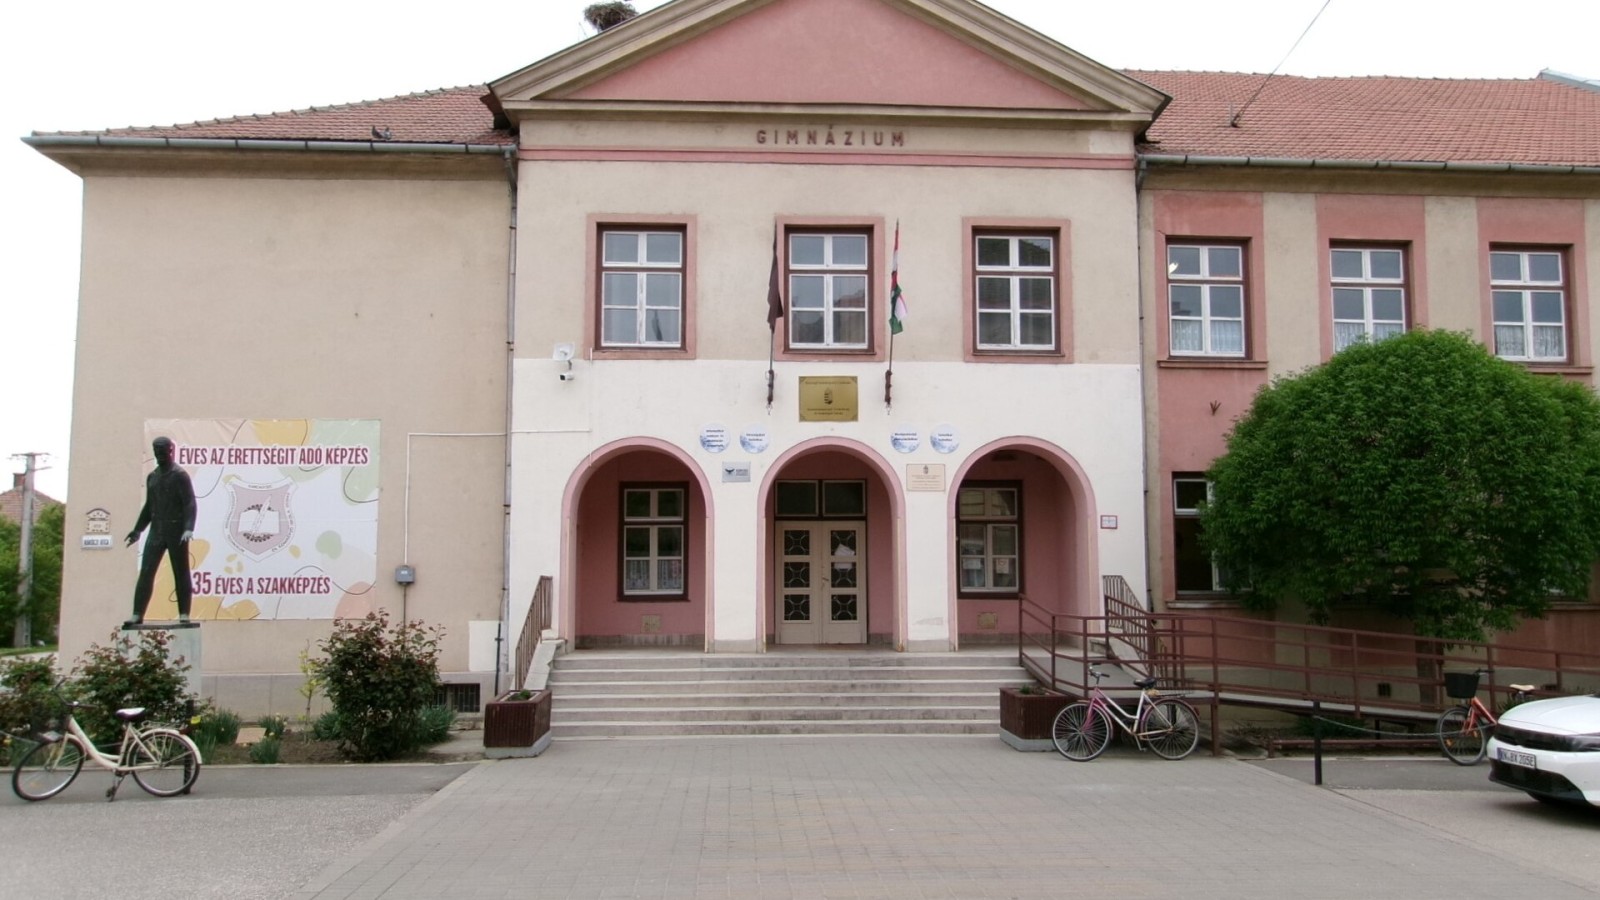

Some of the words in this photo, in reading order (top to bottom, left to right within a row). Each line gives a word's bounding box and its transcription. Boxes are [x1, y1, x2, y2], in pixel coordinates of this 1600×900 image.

[756, 123, 905, 147] GIMNÁZIUM
[179, 446, 208, 465] ÉVES
[210, 448, 225, 465] AZ
[228, 446, 296, 465] ÉRETTSÉGIT
[299, 446, 322, 465] ADÓ
[325, 446, 368, 465] KÉPZÉS
[192, 571, 211, 594] 35
[215, 575, 243, 594] ÉVES
[246, 578, 254, 594] A
[257, 575, 330, 594] SZAKKÉPZÉS
